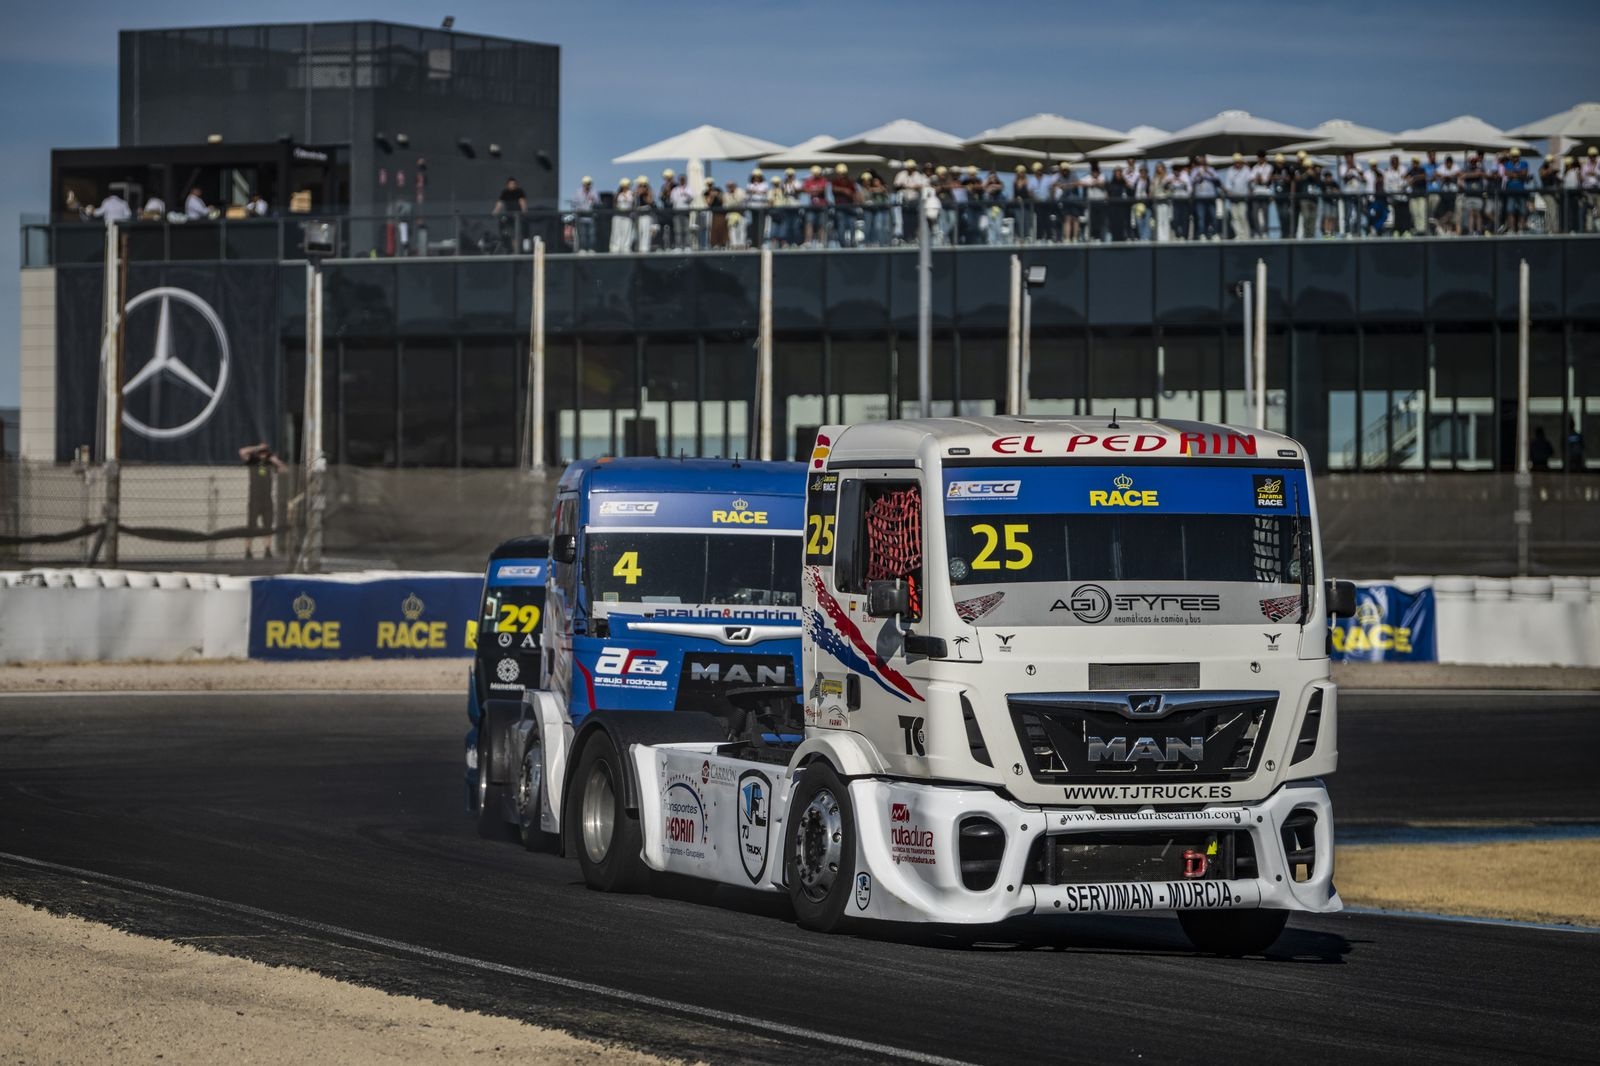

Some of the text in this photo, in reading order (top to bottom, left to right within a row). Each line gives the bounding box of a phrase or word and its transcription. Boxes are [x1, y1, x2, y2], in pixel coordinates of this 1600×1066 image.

[991, 435, 1043, 454] EL
[968, 483, 1015, 494] CECC
[1089, 490, 1159, 507] RACE
[1257, 492, 1283, 500] Jarama
[712, 510, 769, 524] RACE
[807, 514, 835, 555] 25
[970, 523, 1033, 571] 25
[612, 551, 643, 585] 4
[498, 604, 541, 633] 29
[1114, 613, 1152, 624] neumáticos
[1189, 613, 1201, 624] bus
[266, 620, 341, 649] RACE
[377, 621, 448, 649] RACE
[691, 662, 786, 684] MAN
[1087, 736, 1204, 762] MAN
[1063, 786, 1232, 800] WWW.TJTRUCK.ES
[891, 825, 934, 847] rutadura
[1066, 883, 1154, 912] SERVIMAN
[1166, 881, 1233, 909] MURCIA
